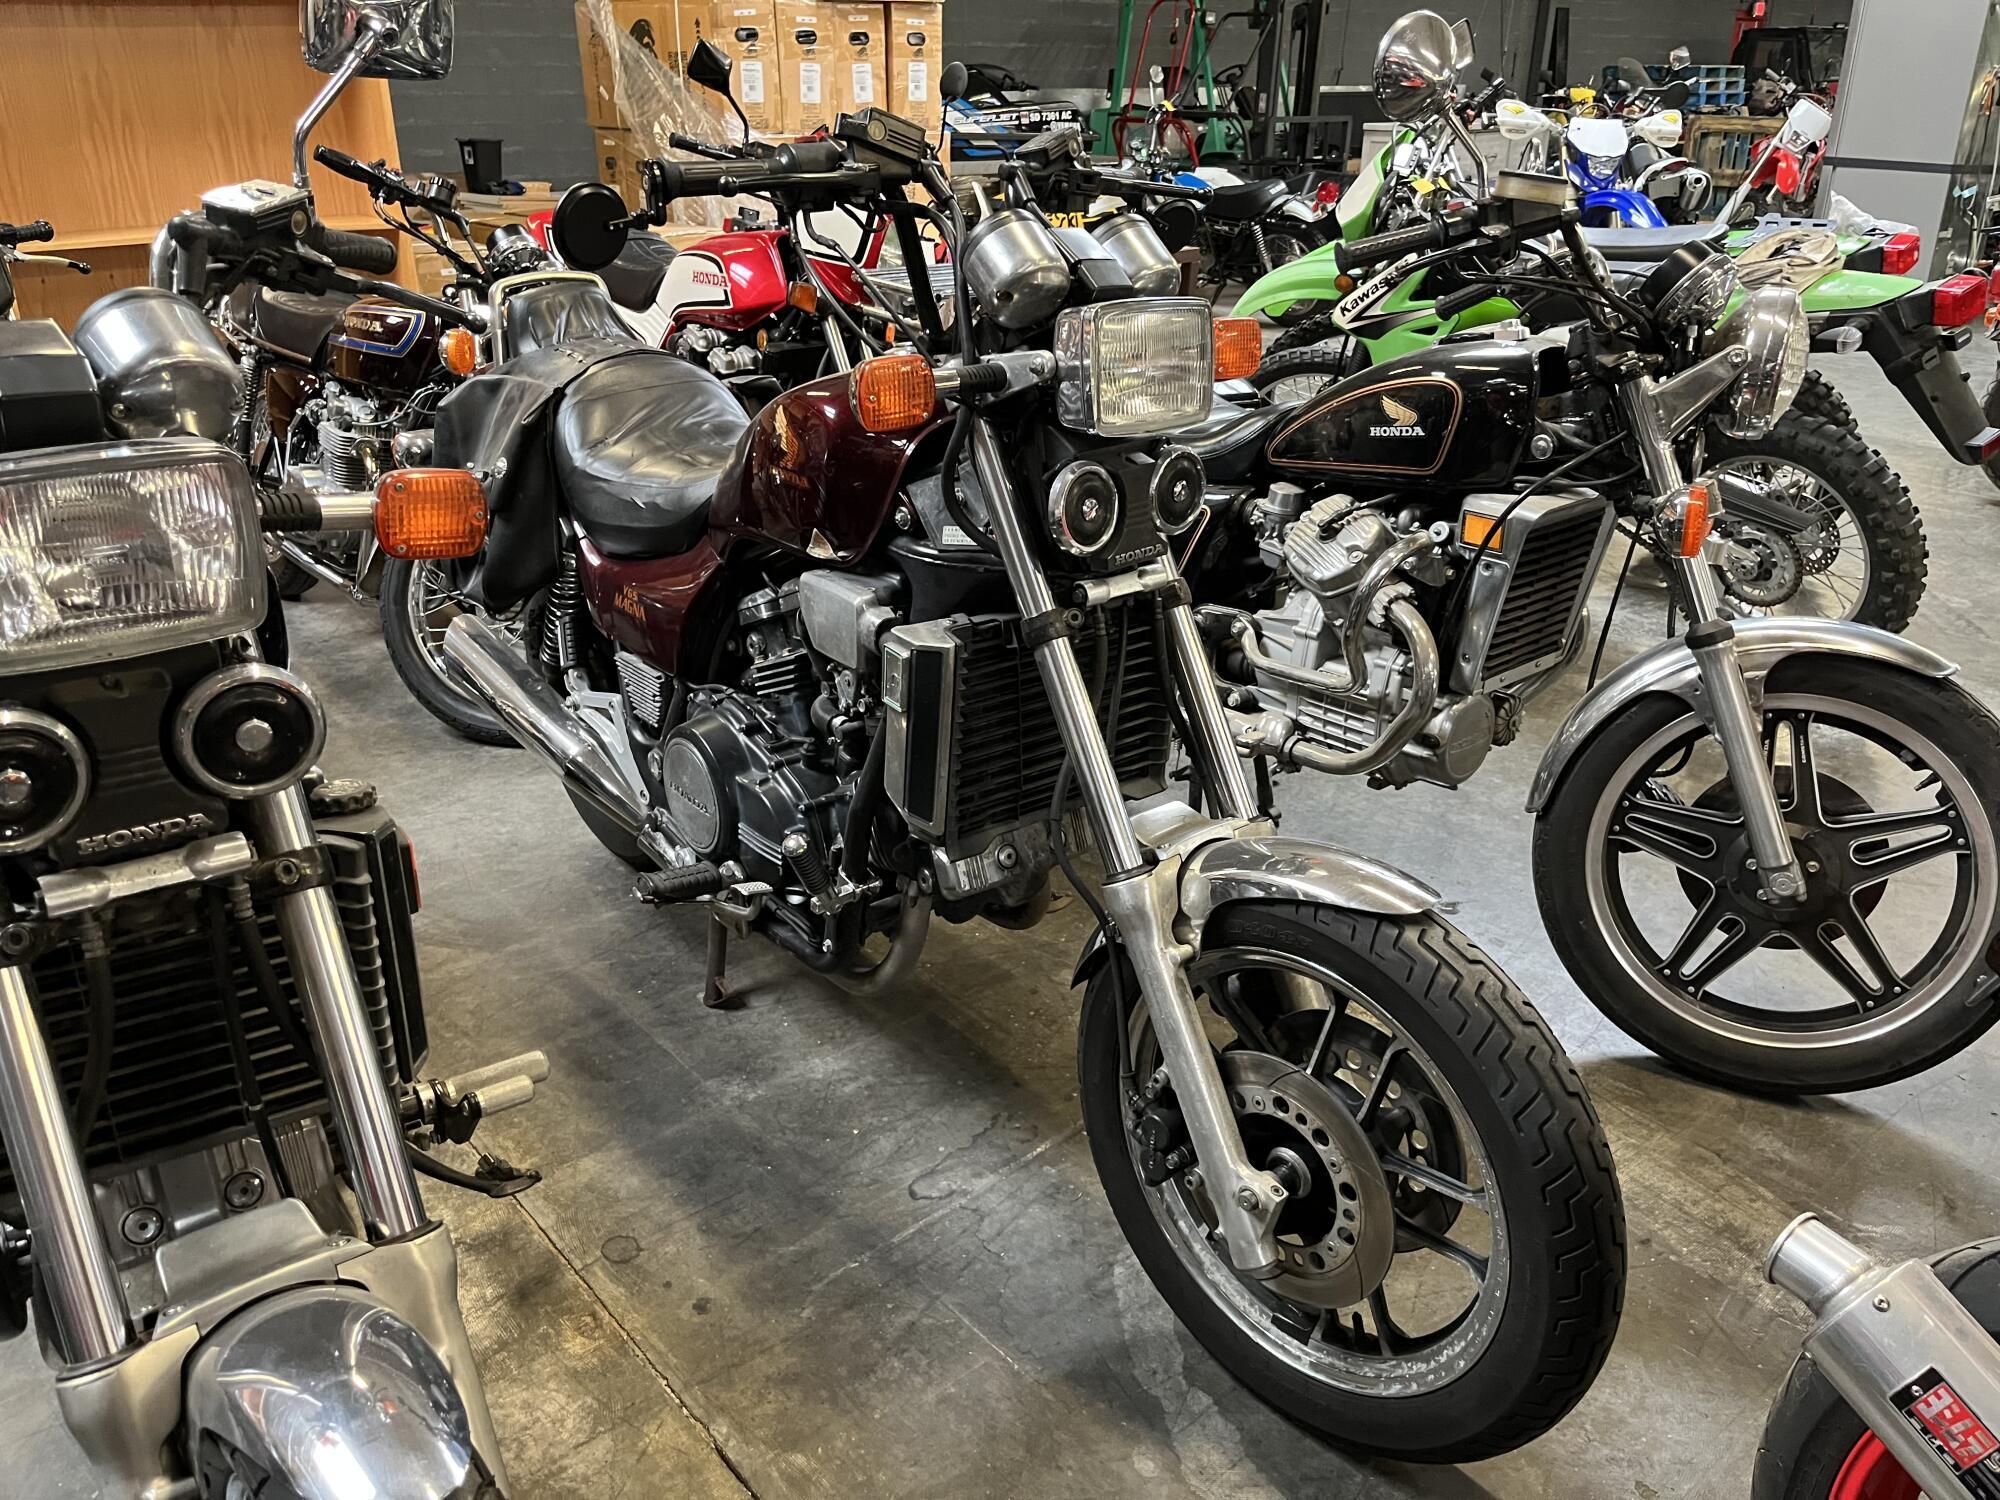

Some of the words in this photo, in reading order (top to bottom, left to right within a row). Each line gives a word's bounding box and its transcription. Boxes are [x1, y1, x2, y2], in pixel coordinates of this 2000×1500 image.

[1029, 112, 1041, 122] SD
[1061, 110, 1073, 120] AC
[692, 271, 729, 288] HONDA
[1340, 258, 1410, 317] Kawas
[1369, 426, 1426, 437] HONDA
[1114, 543, 1165, 567] HONDA
[614, 592, 647, 622] MAGNA
[76, 813, 215, 856] HONDA
